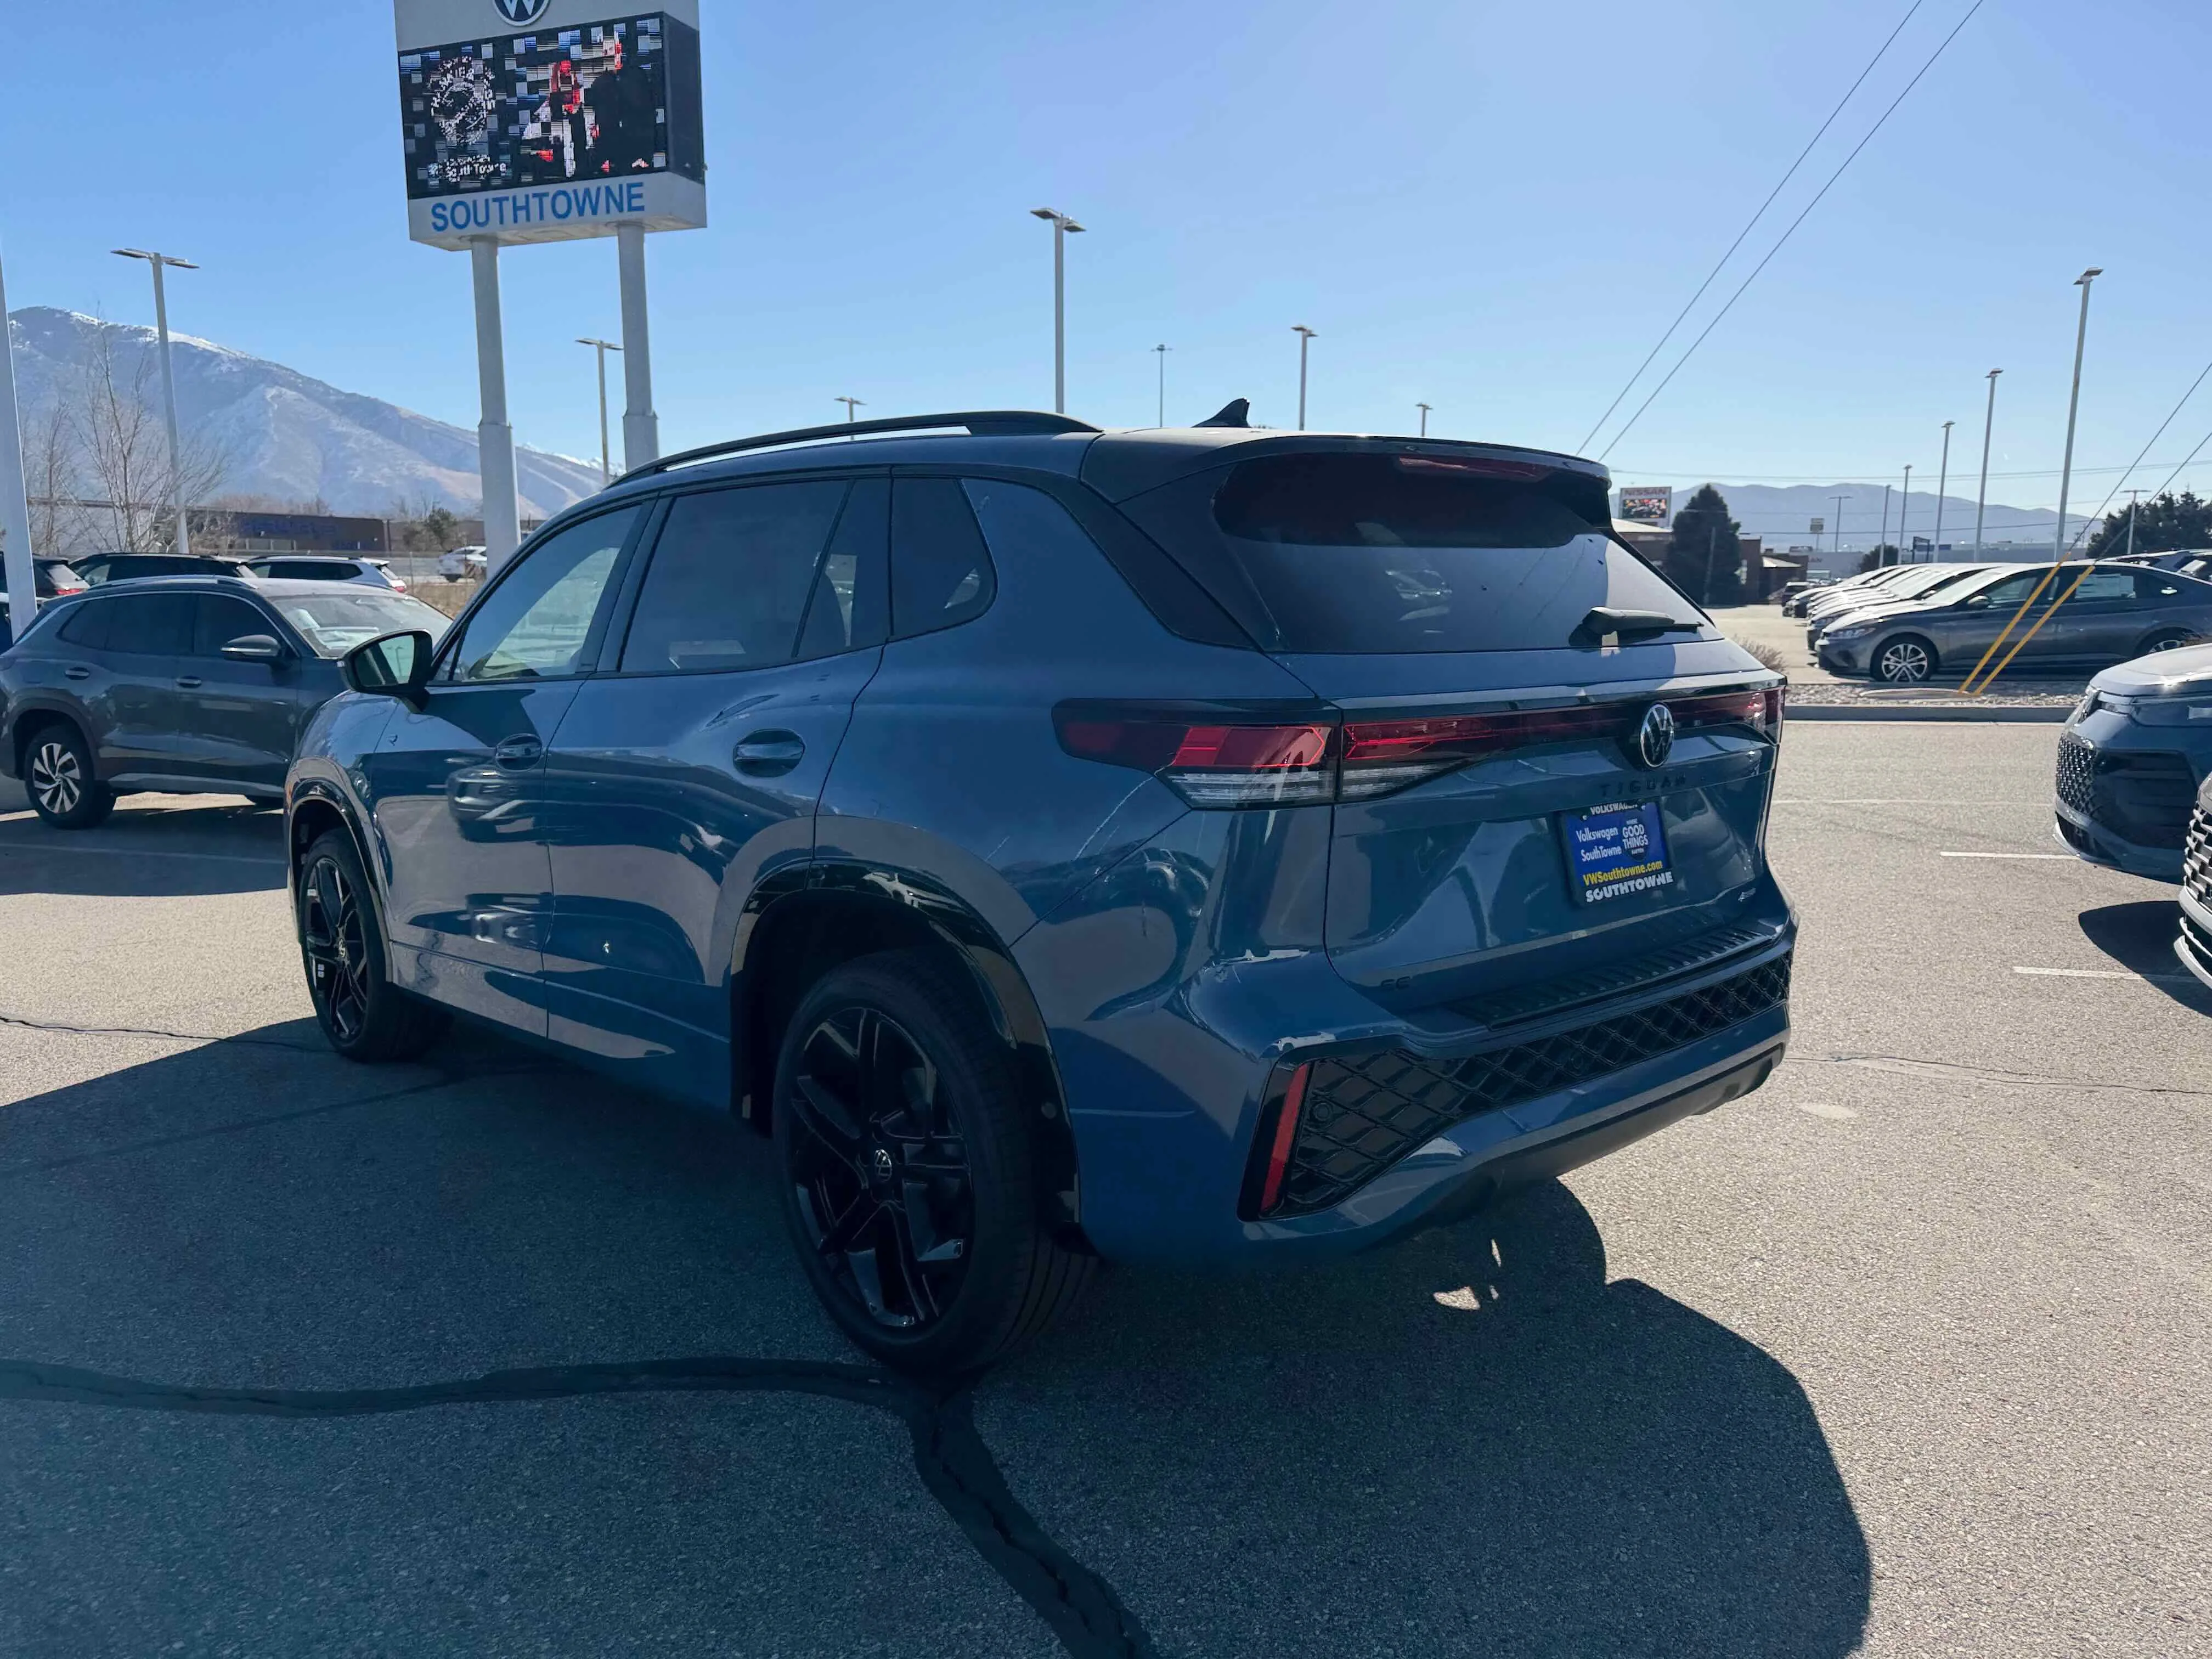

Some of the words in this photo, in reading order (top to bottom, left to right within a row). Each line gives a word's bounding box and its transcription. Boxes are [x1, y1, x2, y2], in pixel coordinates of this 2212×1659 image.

[431, 182, 645, 232] SOUTHTOWNE
[1600, 774, 1686, 797] TIGUAN
[1576, 827, 1619, 843] Volkswagen
[1622, 824, 1645, 838] GOOD
[1622, 834, 1649, 850] THINGS
[1581, 845, 1622, 862] SouthTowne
[1583, 860, 1663, 887] VWSouthtowne.com
[1585, 871, 1673, 902] SOUTHTOWNE
